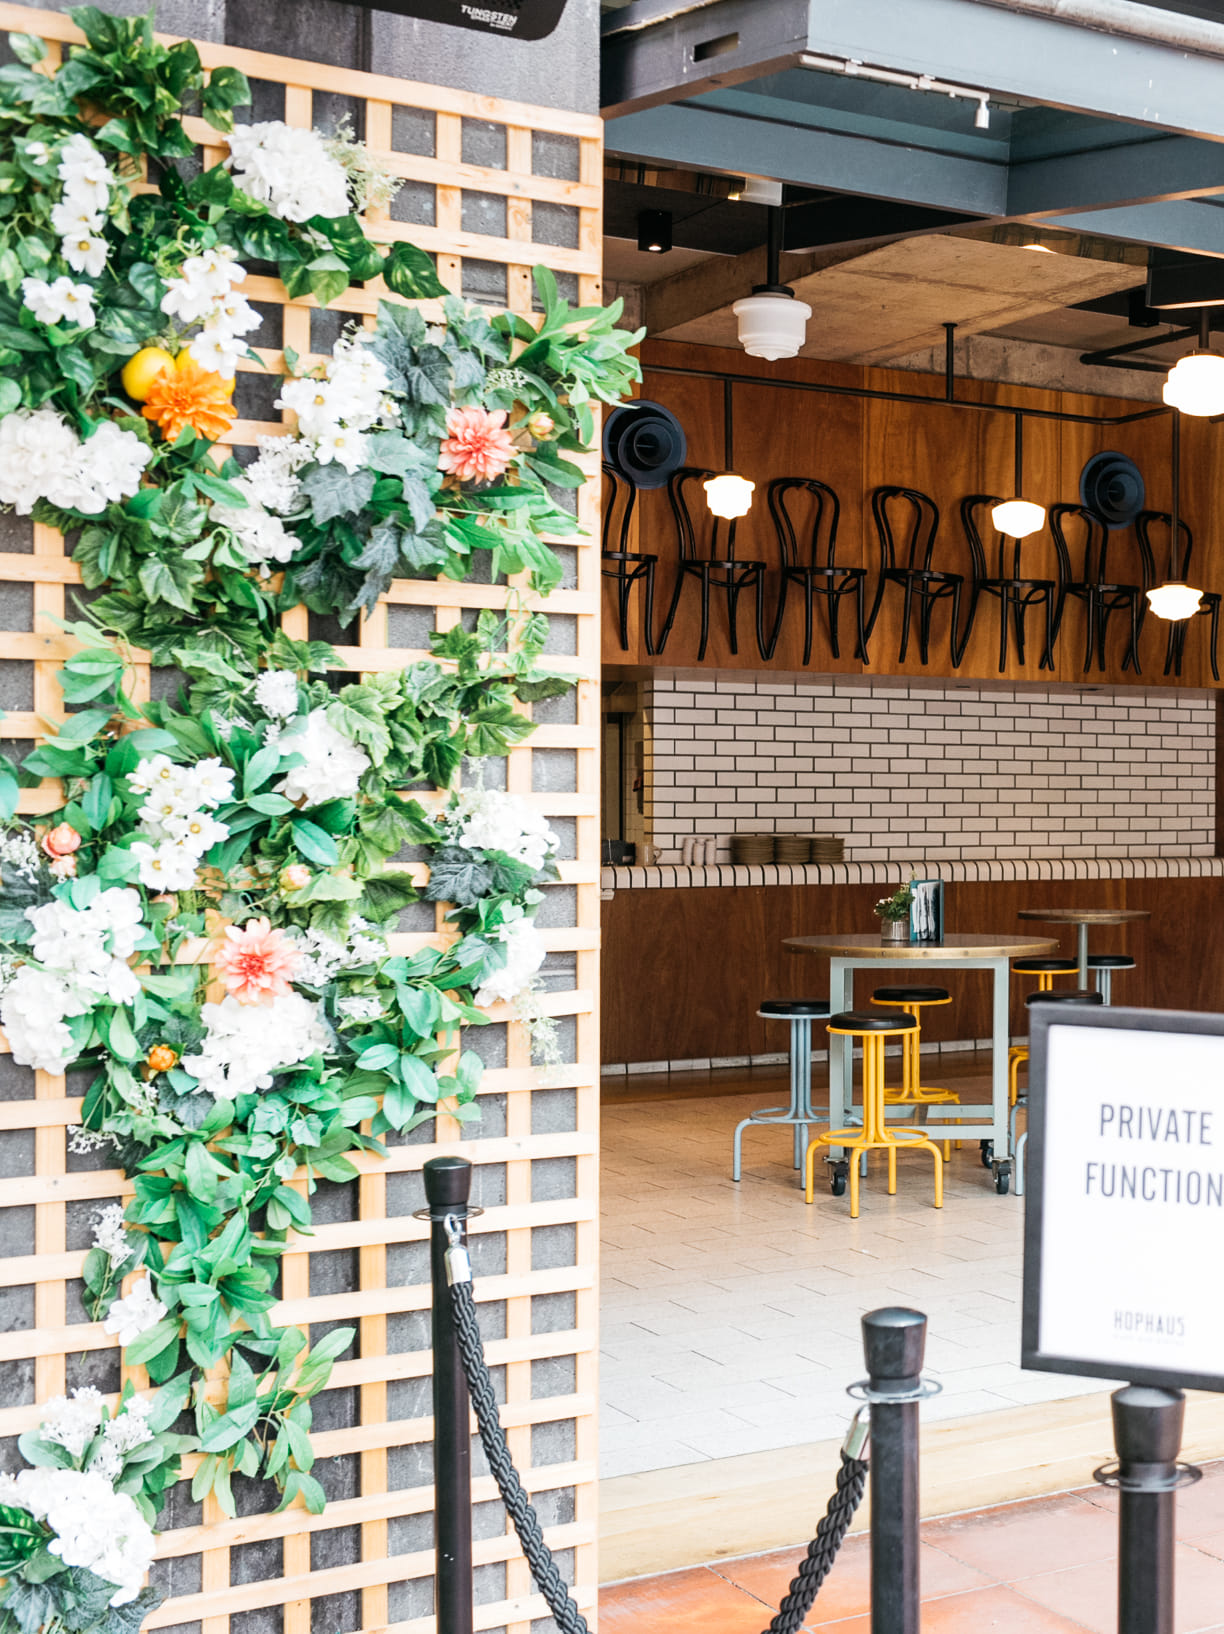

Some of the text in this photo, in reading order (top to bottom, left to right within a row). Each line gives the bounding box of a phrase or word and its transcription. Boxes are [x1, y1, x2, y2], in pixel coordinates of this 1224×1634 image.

[461, 5, 518, 24] TUNGSTEN
[1100, 1104, 1213, 1145] PRIVATE
[1085, 1162, 1223, 1207] FUNCTION
[1114, 1310, 1185, 1337] HOPHAUS
